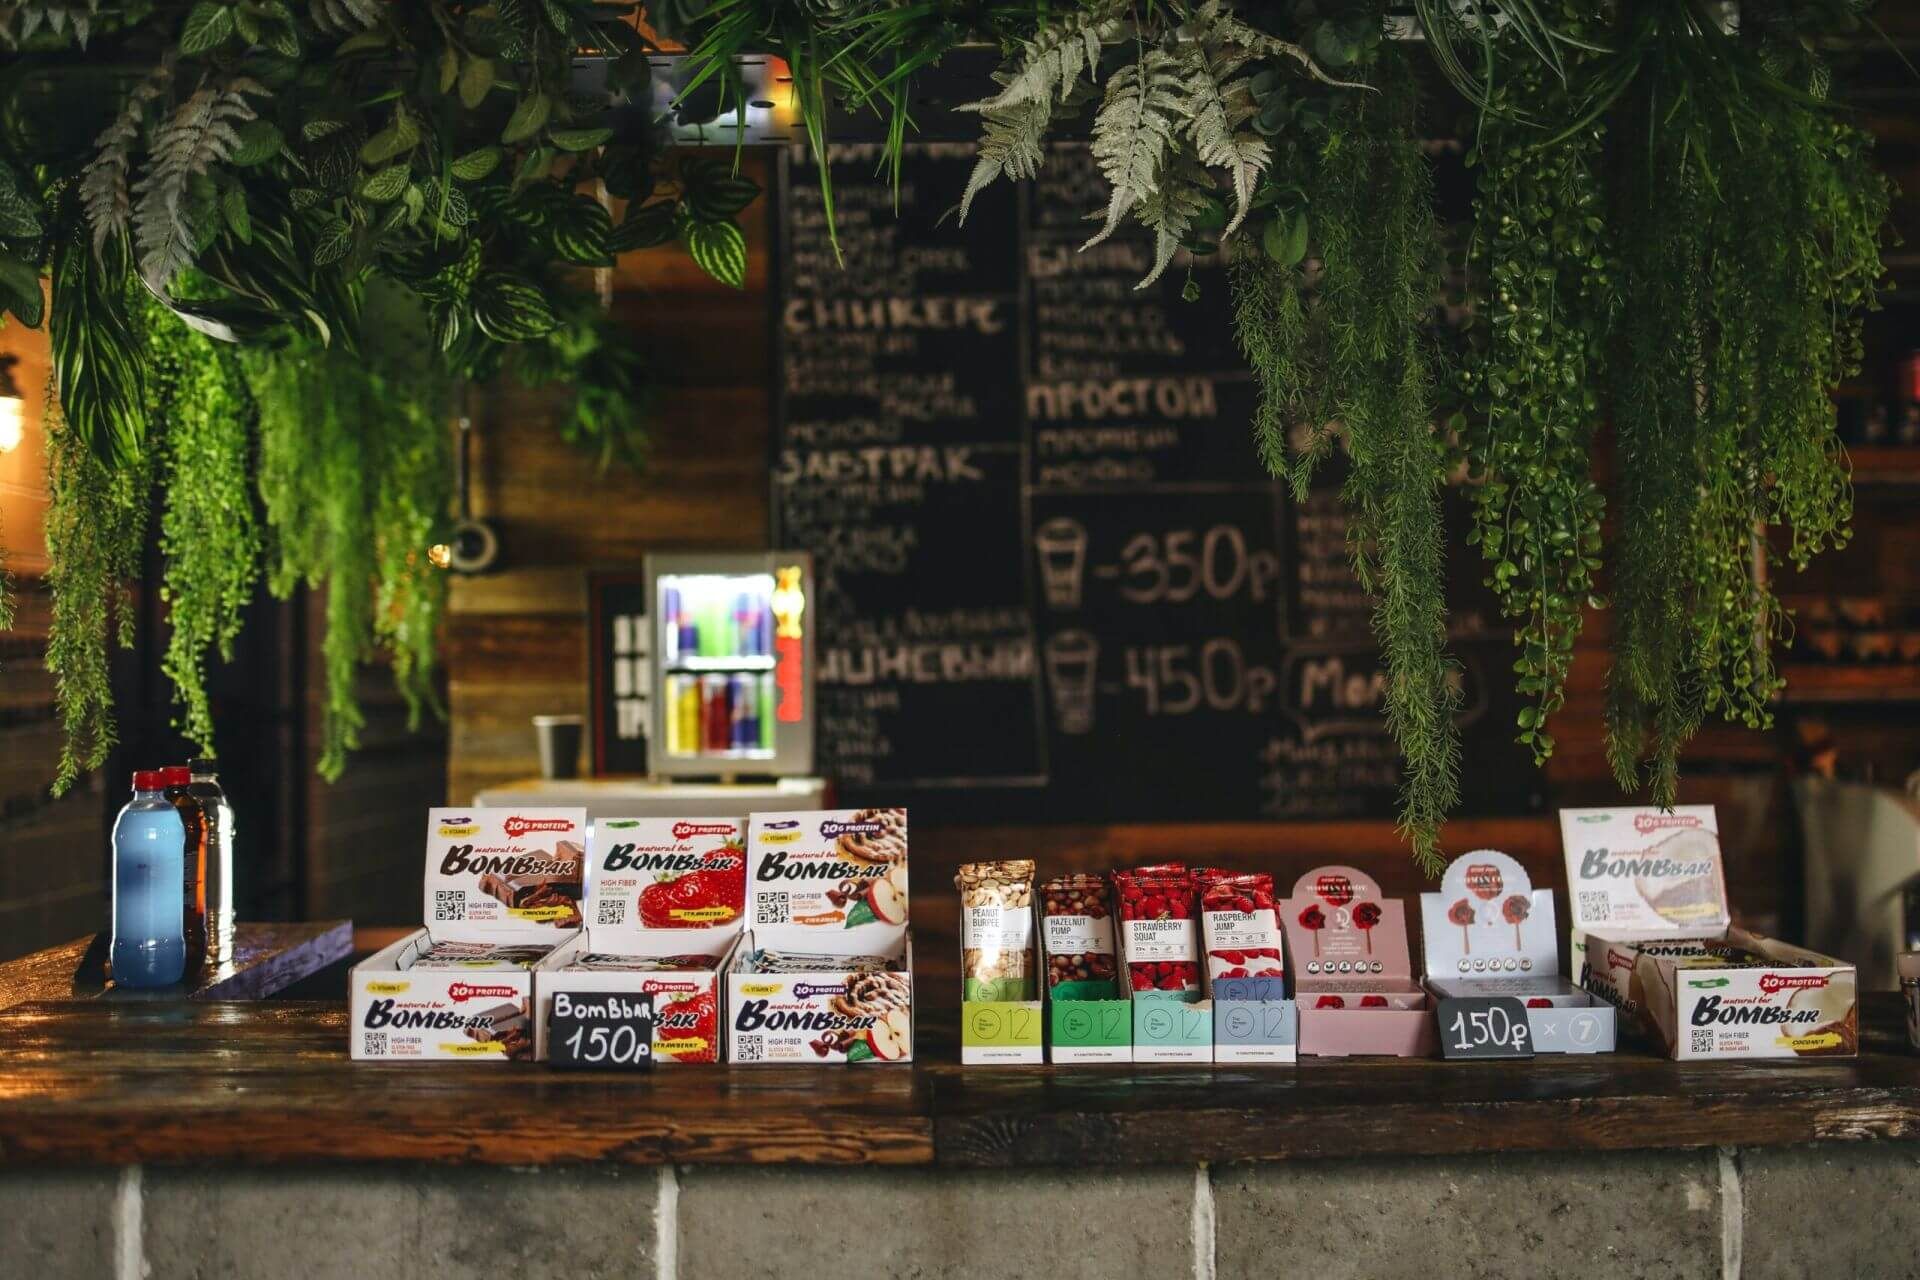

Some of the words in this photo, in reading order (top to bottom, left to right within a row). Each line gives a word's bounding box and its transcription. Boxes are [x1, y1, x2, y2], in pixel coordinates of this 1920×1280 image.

[845, 824, 880, 832] PROTEIN
[972, 909, 999, 917] PEANUT
[1213, 910, 1257, 921] RASPBERRY
[972, 918, 1000, 927] BURPEE
[1050, 918, 1086, 926] HAZELNUT
[1133, 922, 1183, 931] STRAWBERRY
[1214, 923, 1235, 932] JUMP
[1051, 927, 1071, 935] PUMP
[1134, 932, 1157, 941] SQUAT
[1723, 997, 1756, 1005] natural
